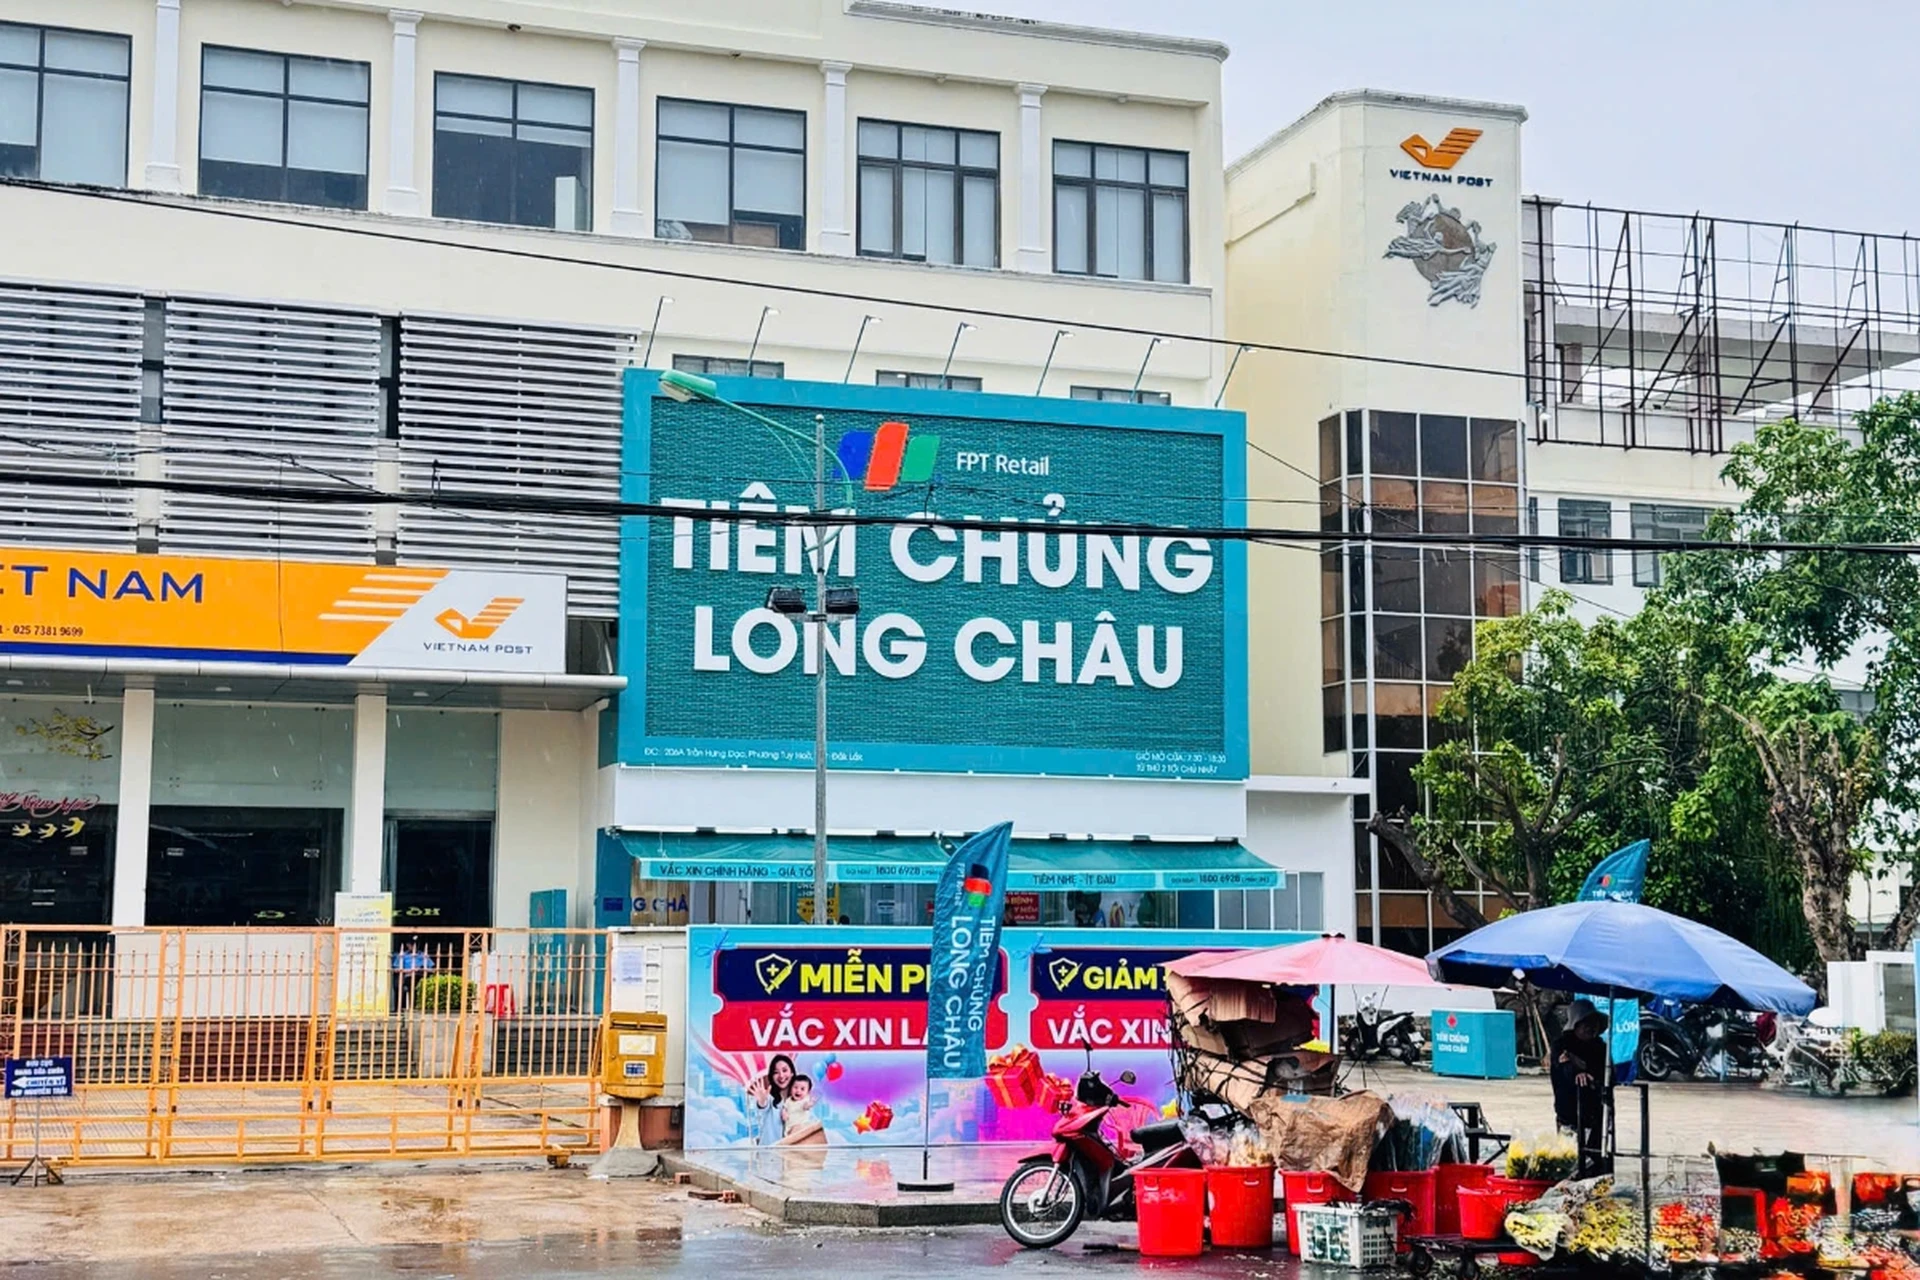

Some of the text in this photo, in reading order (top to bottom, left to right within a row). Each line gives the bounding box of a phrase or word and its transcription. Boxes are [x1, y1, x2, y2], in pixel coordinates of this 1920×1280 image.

[1390, 169, 1493, 187] VIETNAM POST
[956, 452, 1049, 476] FPT Retail
[661, 481, 1213, 594] TIÊM CHỦNG
[0, 565, 204, 603] T NAM
[13, 625, 31, 635] 025
[34, 625, 57, 636] 7381
[423, 642, 533, 654] VIETNAM POST
[694, 605, 1183, 689] LONG CHÂU
[660, 861, 683, 876] VẮC
[686, 866, 701, 876] XIN
[704, 863, 736, 877] CHÍNH
[778, 865, 795, 878] GIÁ
[800, 864, 816, 878] TỐ
[1033, 872, 1056, 885] TIÊM
[800, 949, 892, 993] MIỄN
[1083, 958, 1157, 990] GIẢM
[943, 915, 973, 1069] LONG CHÂU
[968, 961, 990, 1032] CHỦNG
[750, 1002, 825, 1047] VẮC
[833, 1018, 892, 1046] XIN
[1047, 1004, 1172, 1045] VẮC XIN
